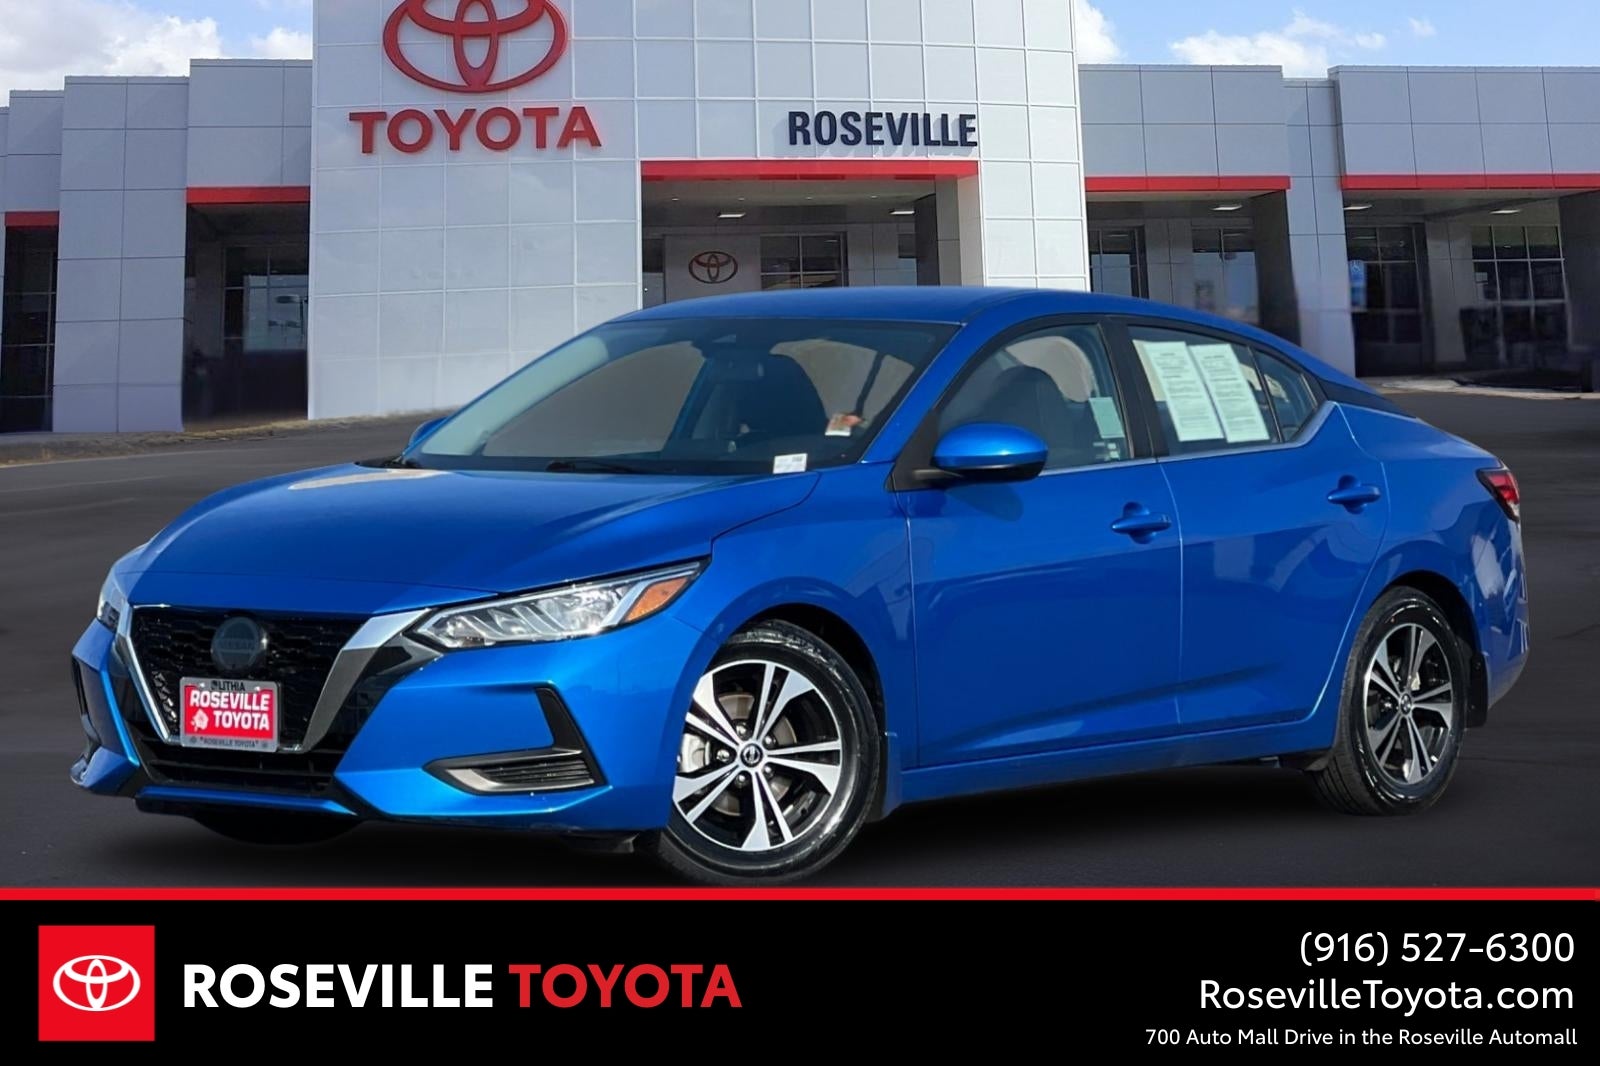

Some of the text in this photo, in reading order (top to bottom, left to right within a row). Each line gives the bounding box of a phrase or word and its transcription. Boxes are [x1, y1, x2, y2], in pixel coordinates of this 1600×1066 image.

[350, 107, 602, 154] TOYOTA
[788, 111, 978, 147] ROSEVILLE
[189, 690, 270, 711] ROSEVILLE
[213, 710, 270, 731] TOYOTA
